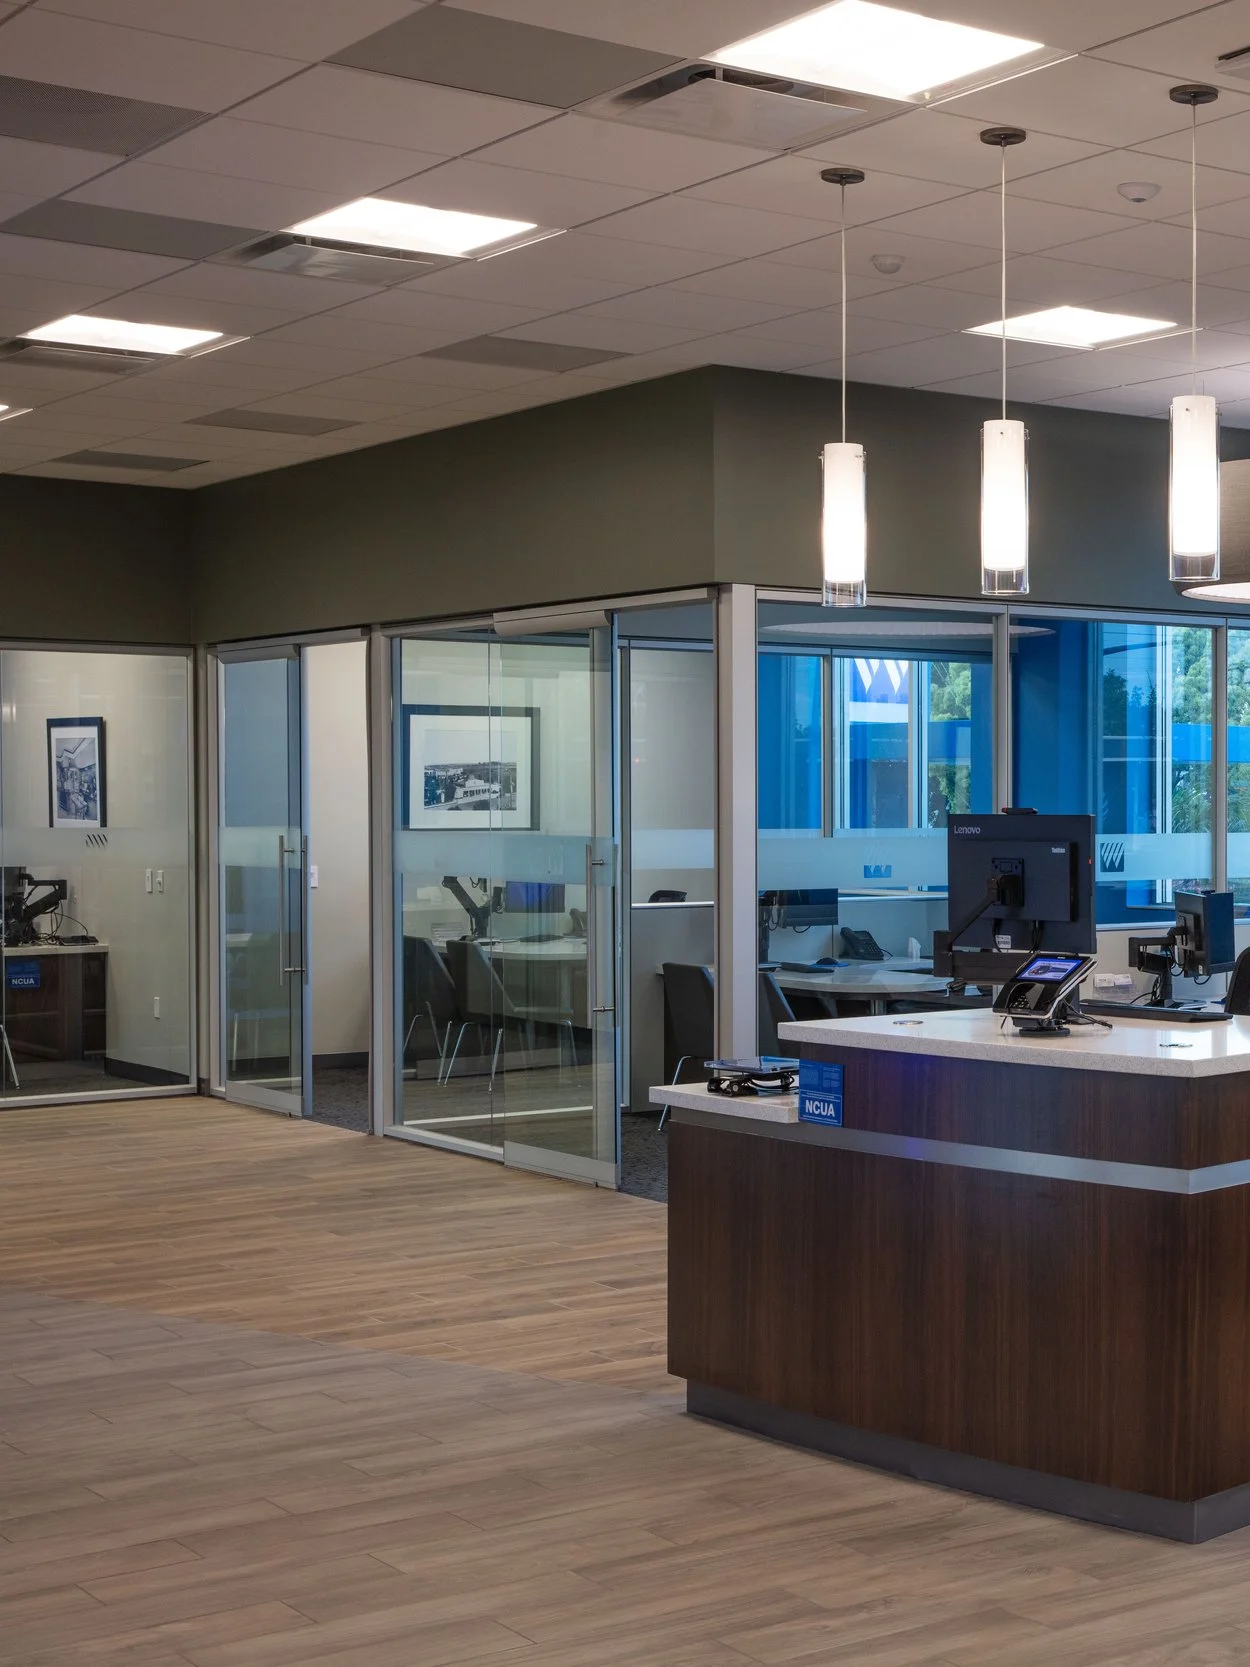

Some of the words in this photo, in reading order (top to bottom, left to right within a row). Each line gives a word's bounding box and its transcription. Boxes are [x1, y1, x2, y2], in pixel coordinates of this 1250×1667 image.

[954, 824, 981, 835] Lenovo
[11, 977, 35, 985] NCUA
[805, 1100, 835, 1117] NCUA
